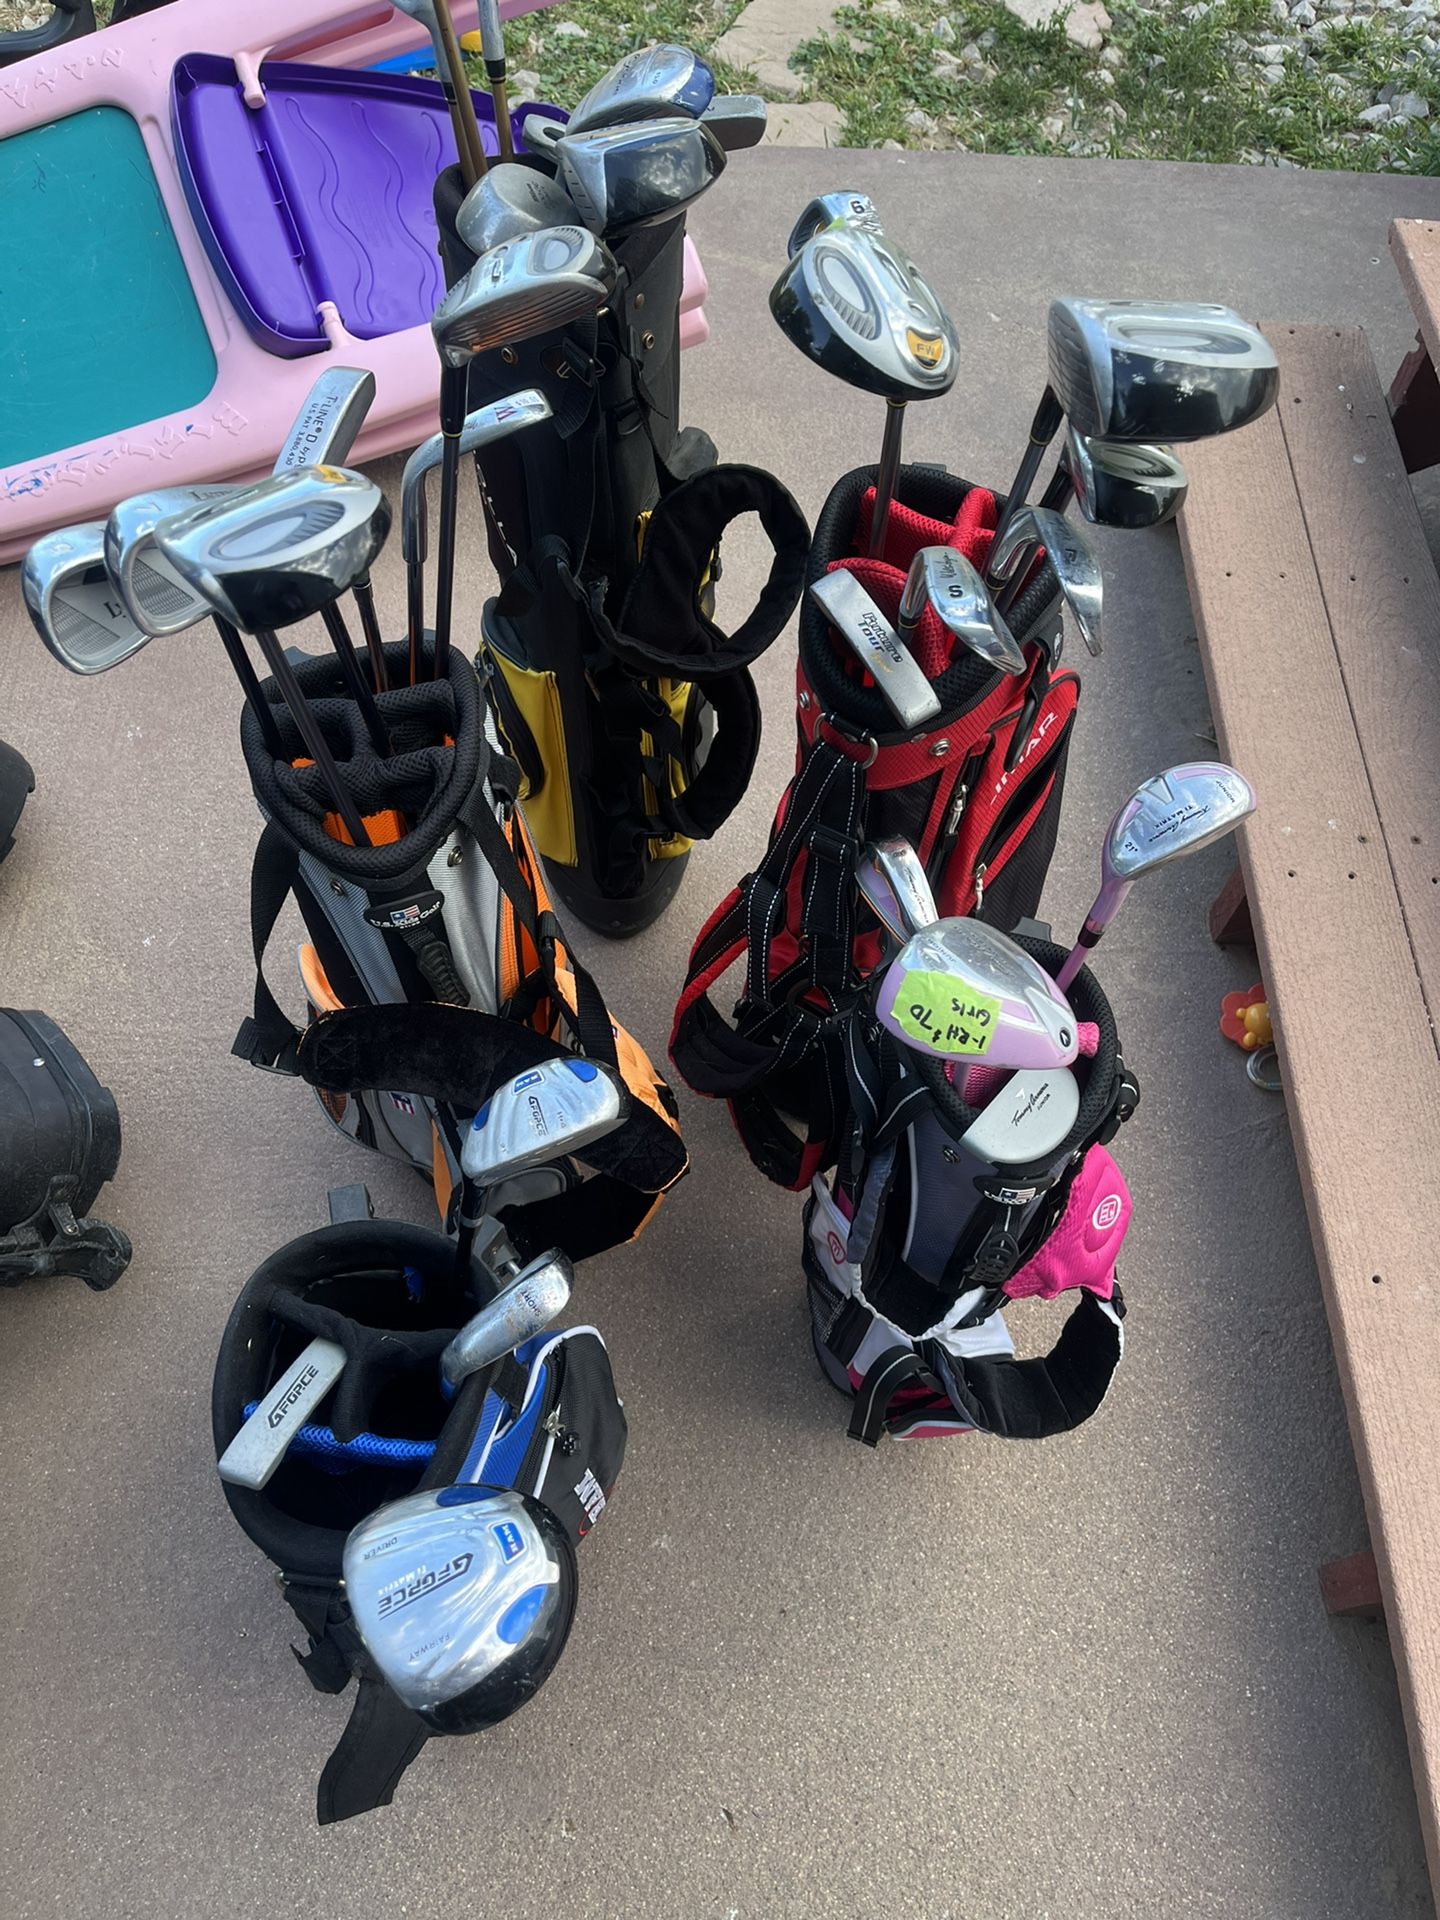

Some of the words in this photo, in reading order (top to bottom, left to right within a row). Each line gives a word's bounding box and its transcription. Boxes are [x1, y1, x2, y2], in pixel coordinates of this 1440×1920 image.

[948, 584, 964, 598] S
[857, 620, 885, 652] Tour
[1215, 780, 1236, 803] JUNIOR
[520, 1290, 542, 1318] SHORT
[267, 1363, 319, 1429] GFORCE
[573, 1467, 607, 1525] RAM
[363, 1536, 398, 1561] DRIVER
[377, 1552, 474, 1622] GFORCE
[408, 1632, 450, 1662] FAIRWAY
